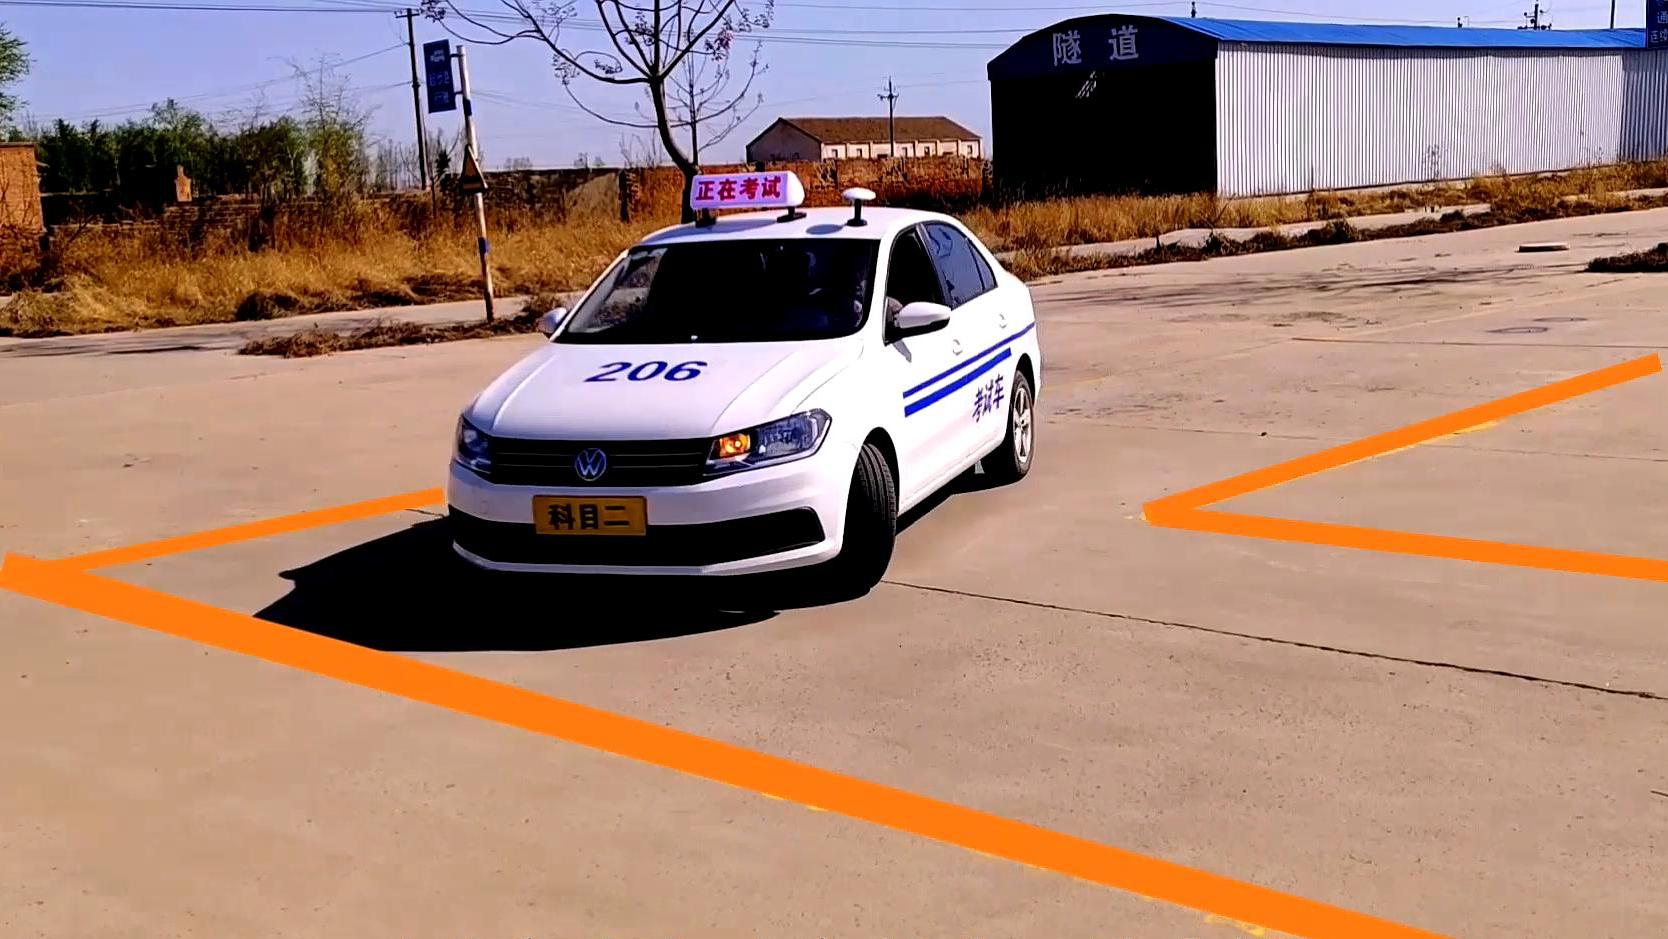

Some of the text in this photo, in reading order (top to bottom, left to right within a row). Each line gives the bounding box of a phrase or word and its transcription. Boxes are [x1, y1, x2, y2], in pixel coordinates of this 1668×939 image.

[1053, 25, 1139, 67] 隧道
[696, 176, 781, 201] 正在考试
[583, 360, 708, 382] 206
[972, 373, 1004, 423] 考试车
[548, 503, 630, 530] 科目二
